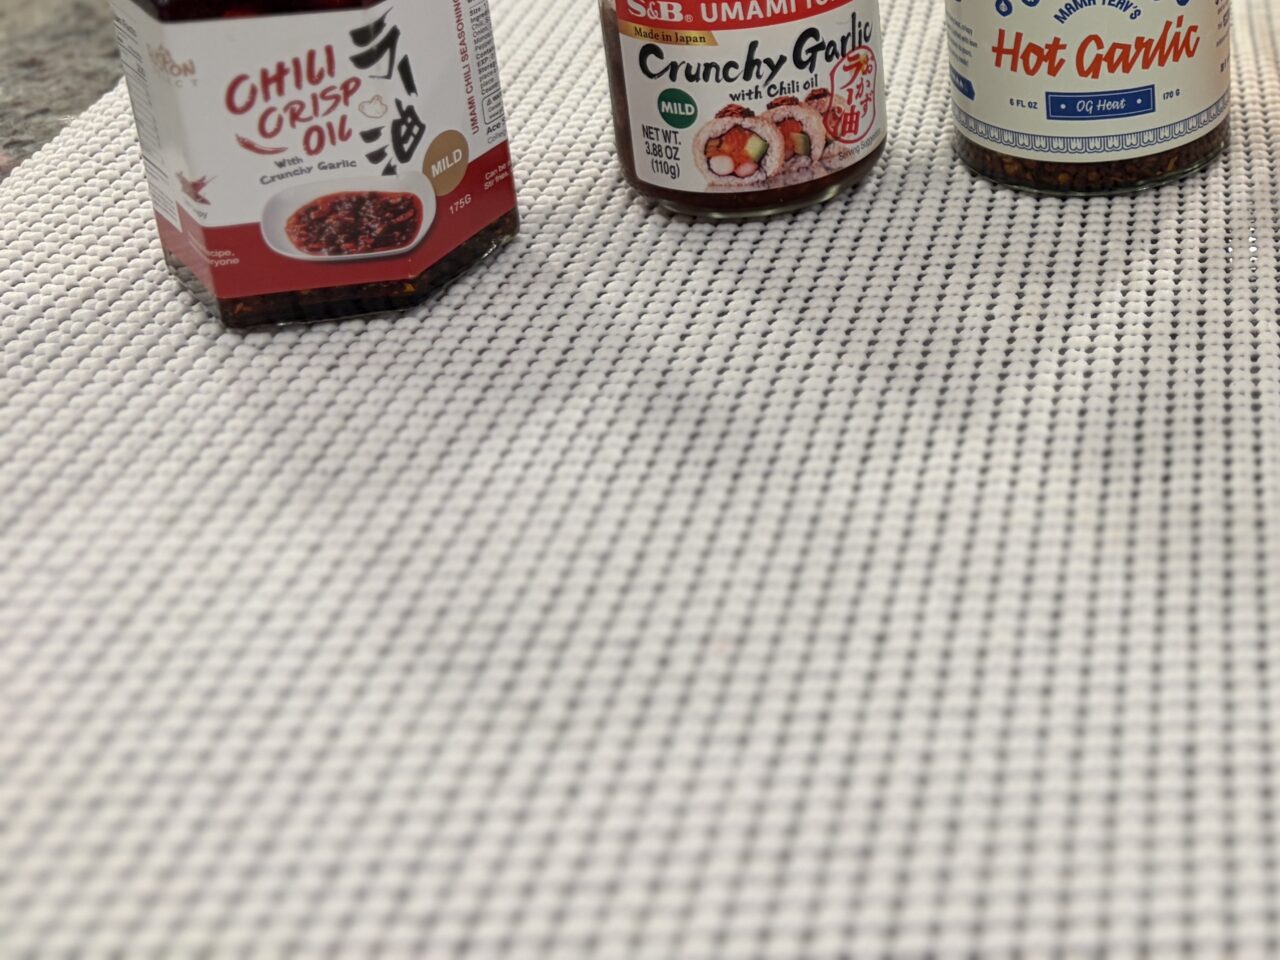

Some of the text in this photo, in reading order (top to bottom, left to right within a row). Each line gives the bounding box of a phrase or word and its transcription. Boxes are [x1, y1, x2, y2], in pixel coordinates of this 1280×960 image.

[634, 25, 707, 45] Made in Japan
[991, 28, 1068, 78] Hot
[1075, 15, 1201, 80] Garlic
[638, 11, 873, 87] Crunchy Garlic
[225, 44, 336, 115] CHILI
[461, 63, 475, 94] CHILI
[729, 74, 819, 103] with Chili oil
[1009, 98, 1038, 109] 6 FL OZ
[1076, 97, 1127, 115] OG Heat
[1163, 88, 1181, 100] 170 G
[258, 77, 362, 139] CRISP
[467, 96, 479, 135] UMAMI
[661, 100, 696, 116] MILD
[303, 114, 353, 156] OIL
[642, 124, 682, 146] NET WT.
[274, 155, 304, 169] With
[431, 148, 463, 178] MILD
[645, 144, 681, 162] 3.88 OZ
[259, 158, 357, 186] Crunchy Garlic
[651, 158, 681, 179] (110g)
[449, 194, 472, 215] 175G
